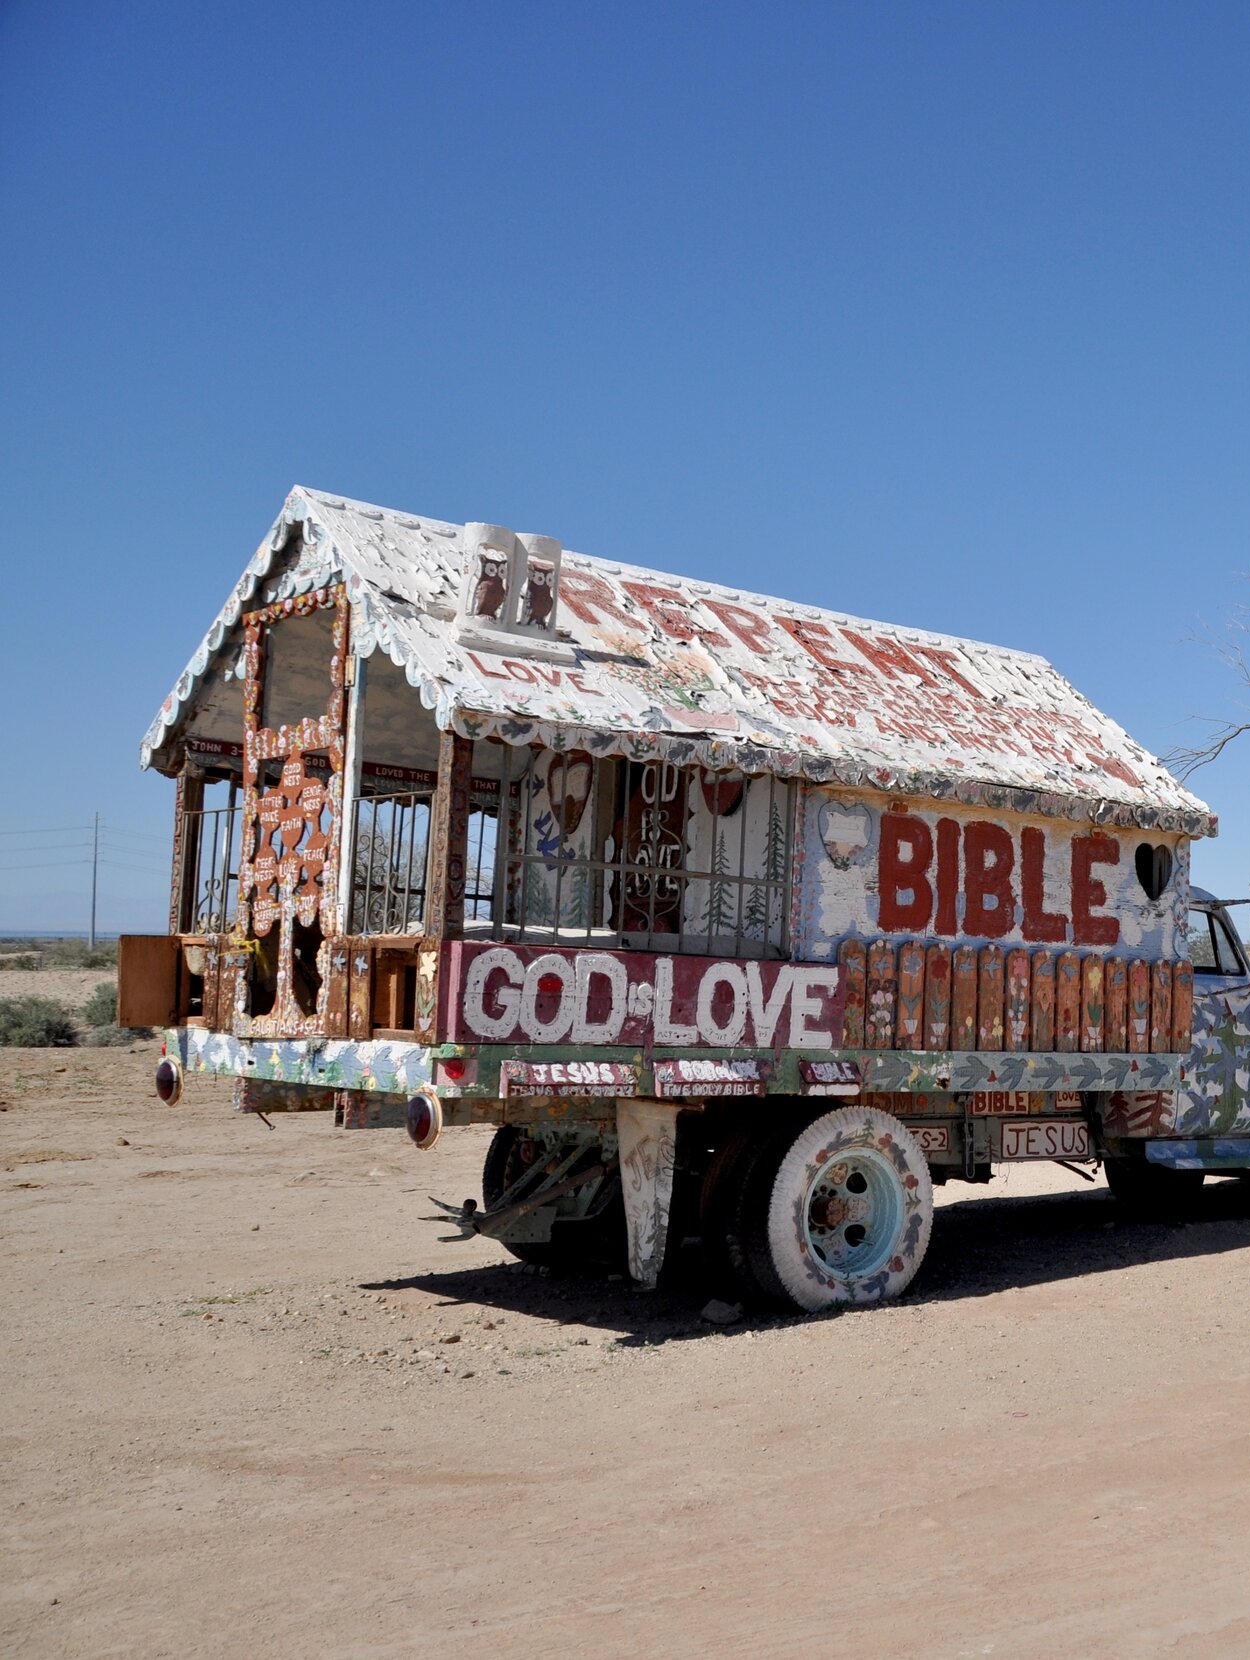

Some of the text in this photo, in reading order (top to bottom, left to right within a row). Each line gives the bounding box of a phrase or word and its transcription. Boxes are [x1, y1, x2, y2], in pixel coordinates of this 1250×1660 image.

[559, 565, 986, 699] REPENT
[467, 652, 604, 695] LOVE
[876, 698, 968, 729] COME
[972, 714, 1060, 744] UPON
[191, 740, 222, 753] JOHN
[867, 715, 945, 744] AND
[947, 728, 1029, 758] INTO
[1030, 742, 1078, 765] MY
[304, 756, 326, 768] GOD
[375, 766, 430, 783] LOVED THE
[473, 779, 498, 791] THAT
[641, 762, 679, 804] OD
[281, 817, 302, 831] FAITH
[877, 811, 1120, 946] BIBLE
[299, 894, 317, 912] JOY
[463, 948, 627, 1043] GOD
[654, 956, 838, 1049] LOVE
[531, 1061, 615, 1084] JESUS
[663, 1083, 692, 1097] THE
[723, 1083, 760, 1096] BIBLE
[974, 1090, 1027, 1113] BIBLE
[1057, 1092, 1081, 1102] LOVE
[1006, 1125, 1088, 1157] JESUS
